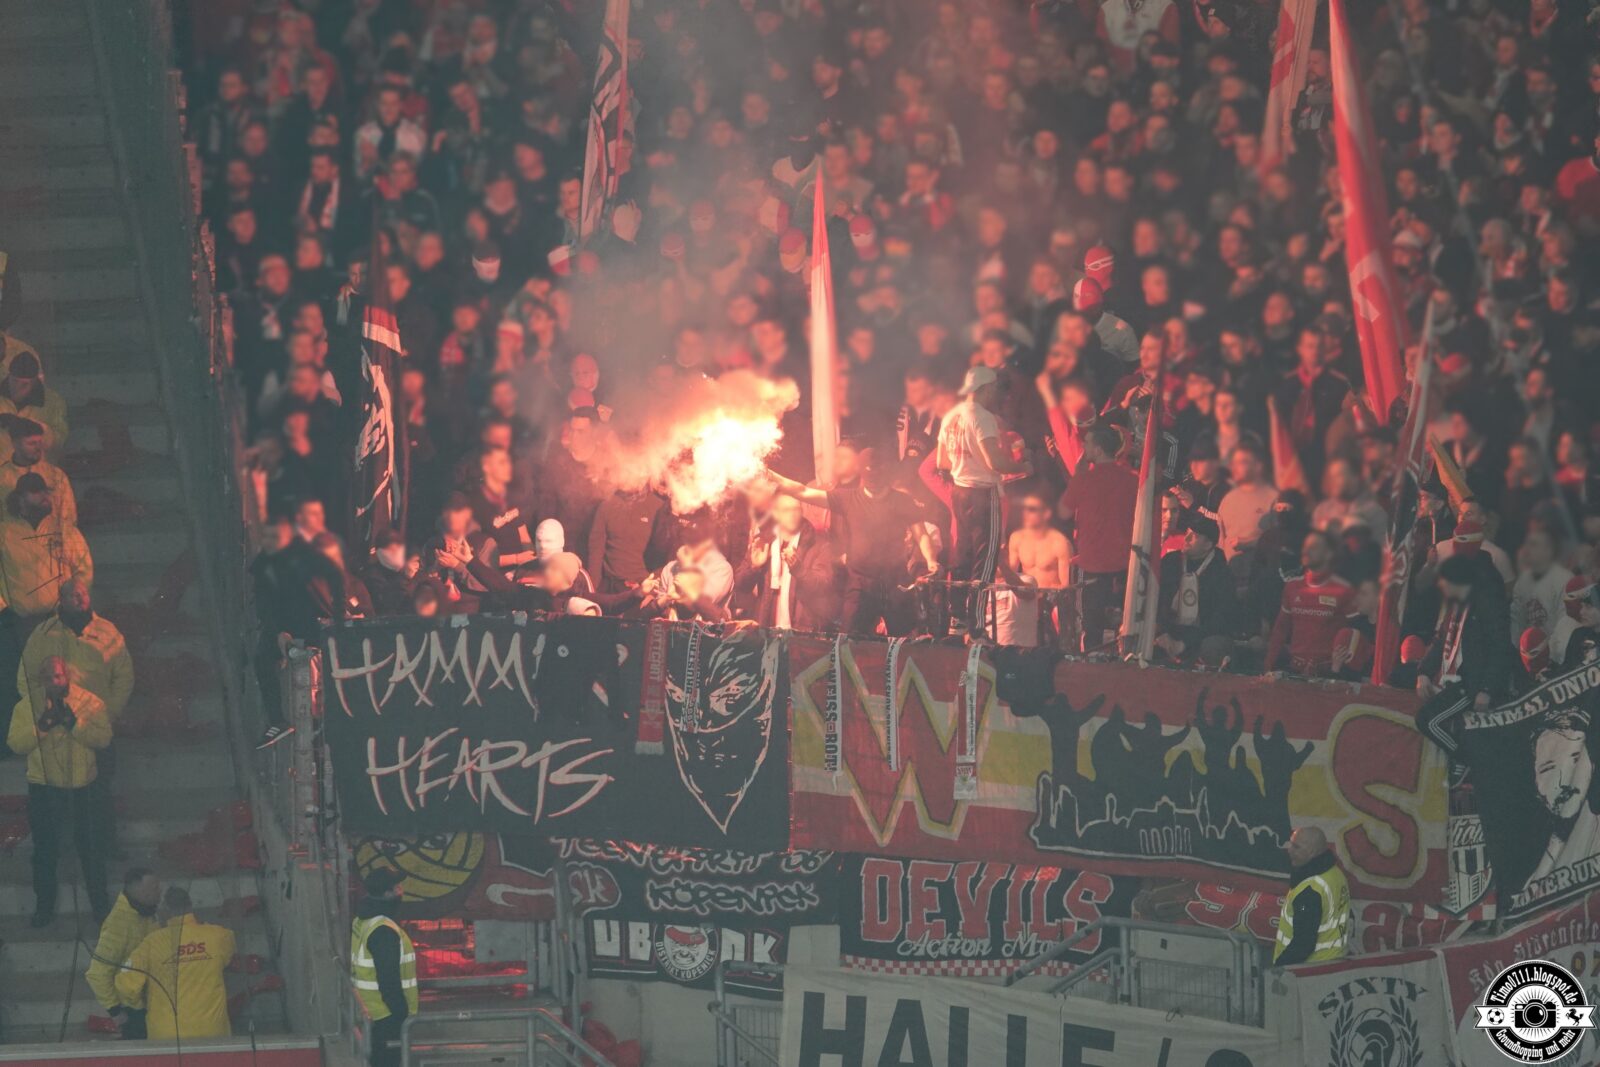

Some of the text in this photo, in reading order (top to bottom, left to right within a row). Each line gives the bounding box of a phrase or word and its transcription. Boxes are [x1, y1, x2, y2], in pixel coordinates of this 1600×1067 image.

[1464, 665, 1600, 730] EINMAL UNIO
[366, 727, 615, 825] HEARTS
[860, 857, 1114, 953] DEVILS
[896, 930, 992, 958] Action
